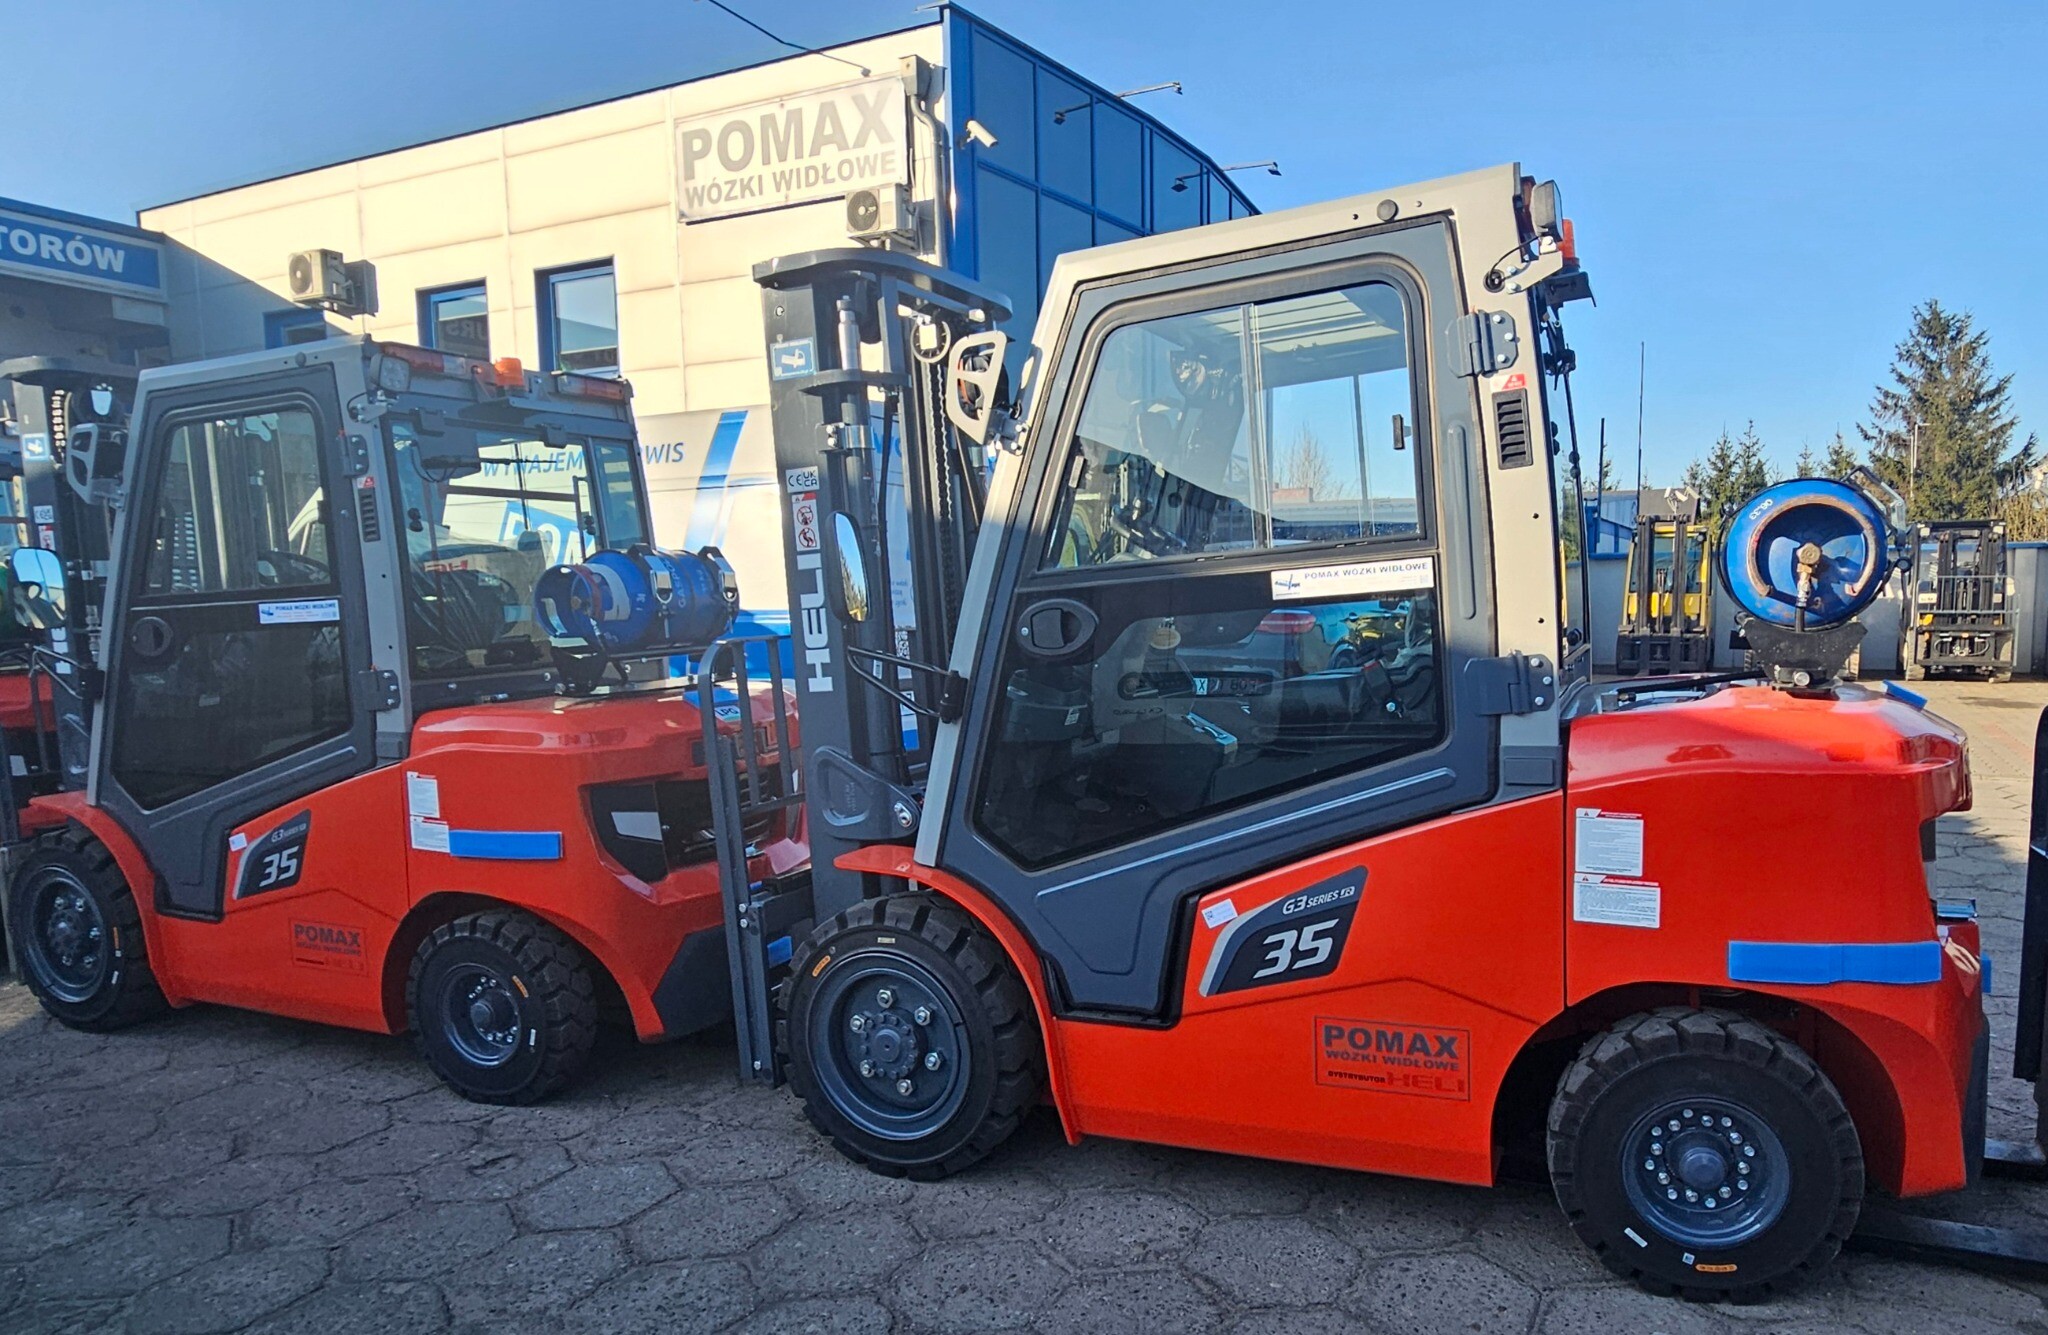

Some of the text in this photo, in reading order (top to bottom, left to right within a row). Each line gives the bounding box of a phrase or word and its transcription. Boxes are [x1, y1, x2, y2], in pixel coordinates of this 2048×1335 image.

[682, 88, 895, 182] POMAX
[685, 150, 897, 209] WÓZKI WIDŁOWE
[641, 442, 685, 465] WIS
[1304, 570, 1340, 580] POMAX
[797, 553, 834, 693] HELI
[714, 707, 739, 717] LPG
[259, 845, 300, 887] 35
[1282, 894, 1308, 915] G3
[1307, 889, 1340, 908] SERIES
[294, 923, 361, 948] POMAX
[1253, 918, 1340, 979] 35
[1323, 1024, 1459, 1060] POMAX
[1382, 1054, 1459, 1072] WIDŁOWE
[1386, 1071, 1465, 1093] HELI
